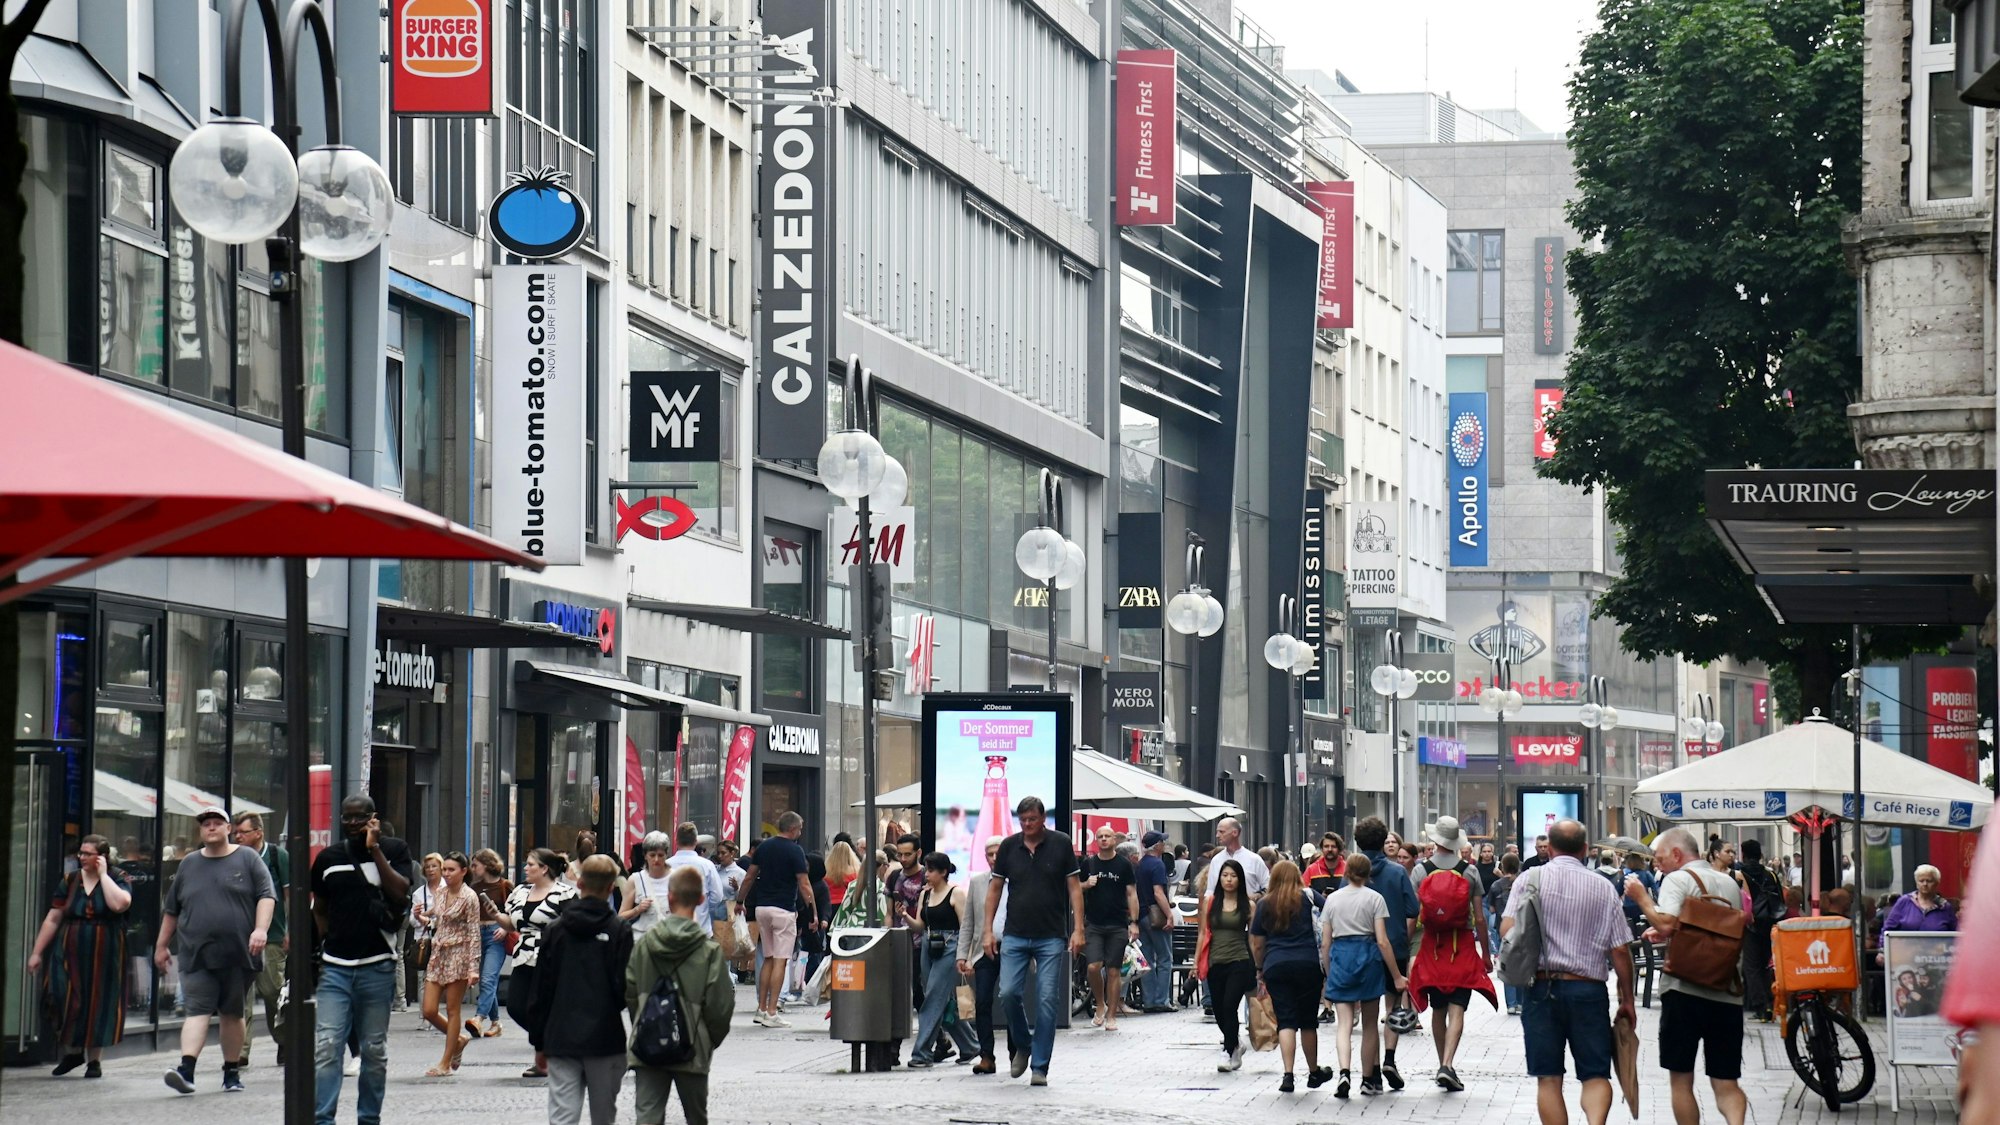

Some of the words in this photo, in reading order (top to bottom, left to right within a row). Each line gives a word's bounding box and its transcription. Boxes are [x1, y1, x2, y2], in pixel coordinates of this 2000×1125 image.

[406, 19, 477, 34] BURGER
[406, 36, 478, 58] KING
[771, 27, 814, 405] CALZEDONIA
[547, 273, 556, 305] SKATE
[547, 313, 556, 341] SURF
[547, 349, 556, 380] SNOW
[521, 273, 545, 557] blue-tomato.com
[649, 384, 701, 448] WMF
[1728, 483, 1858, 503] TRAURING
[1867, 474, 1994, 514] Lounge
[1458, 476, 1482, 547] Apollo
[841, 523, 905, 567] HM
[1352, 569, 1396, 581] TATTOO
[1119, 587, 1161, 607] ZARA
[1351, 583, 1396, 594] PIERCING
[1112, 698, 1155, 708] MODA
[1115, 687, 1152, 698] VERO
[963, 722, 983, 735] Der
[985, 721, 1030, 735] Sommer
[769, 725, 820, 756] CALZEDONIA
[981, 739, 998, 749] seid
[999, 739, 1014, 749] ihr!
[1691, 798, 1719, 810] Café
[1723, 798, 1756, 809] Riese
[1873, 801, 1902, 813] Café
[1906, 803, 1941, 817] Riese
